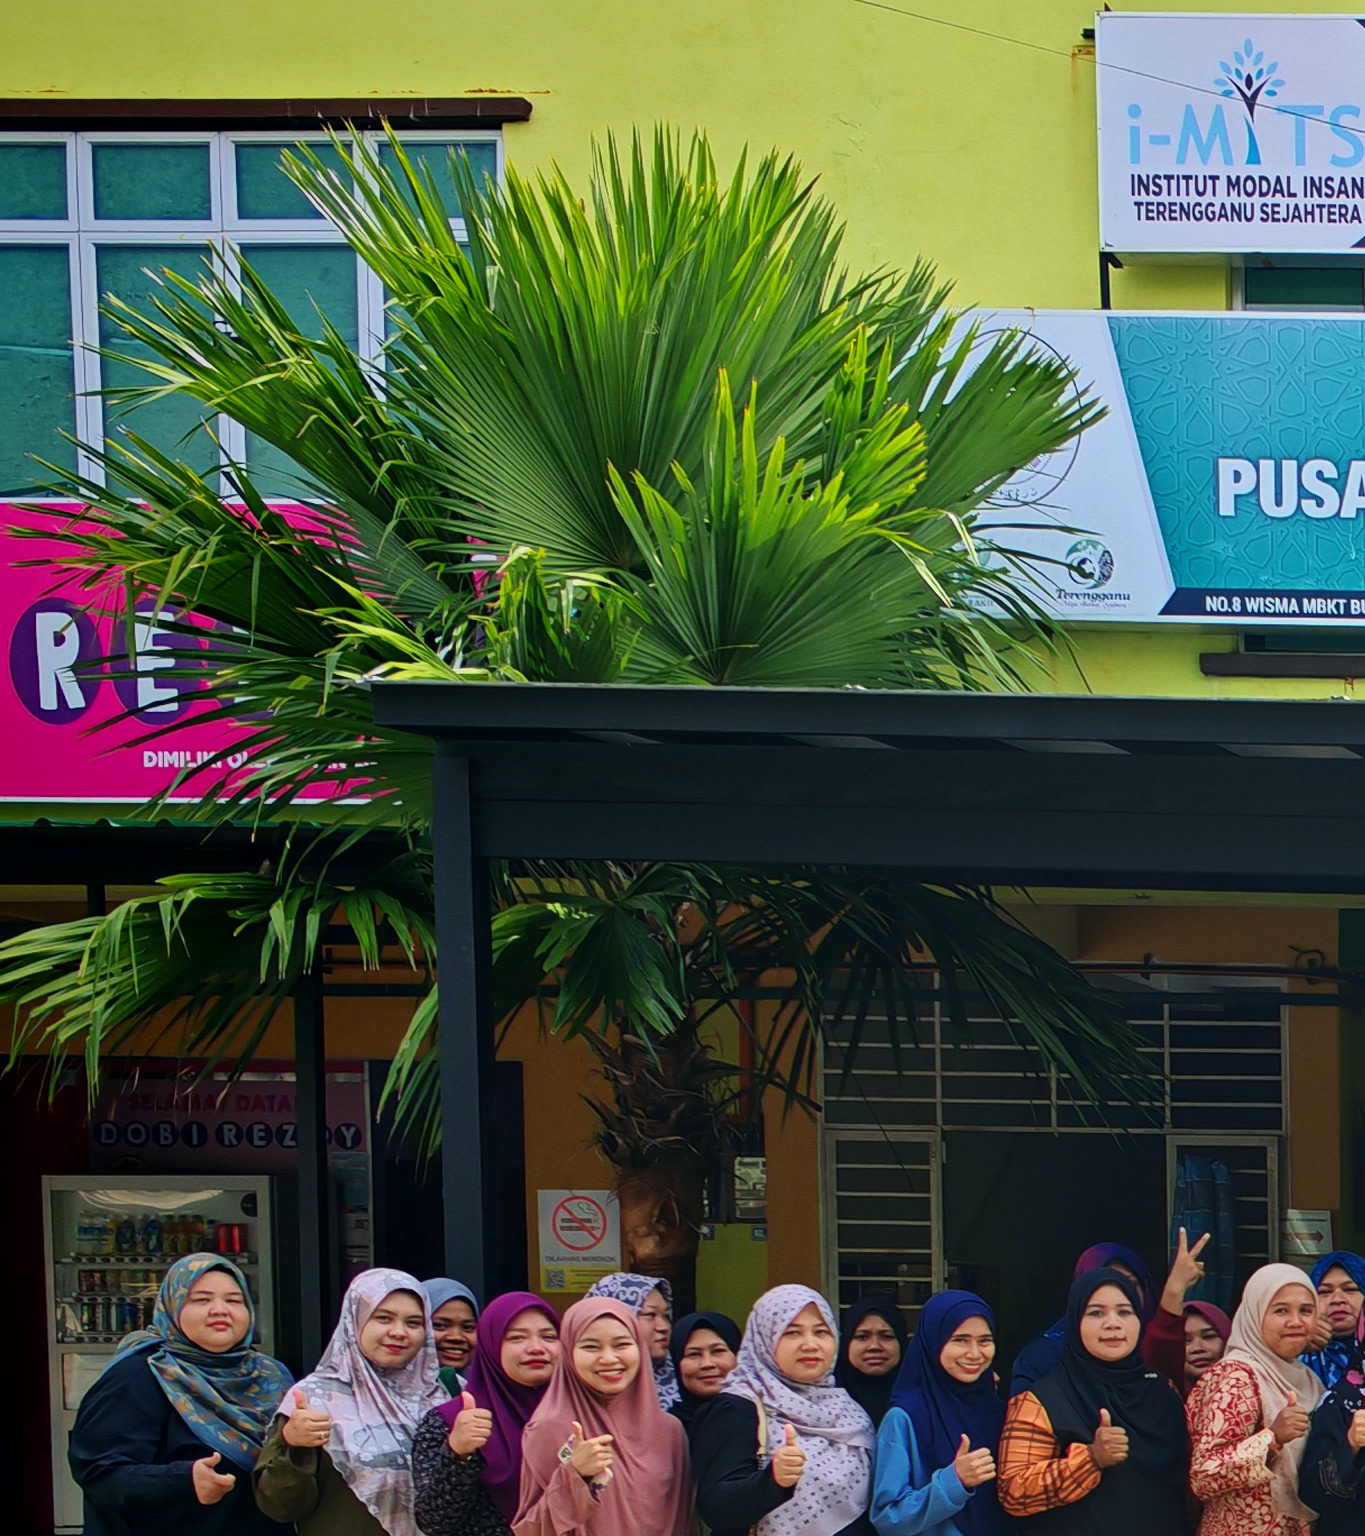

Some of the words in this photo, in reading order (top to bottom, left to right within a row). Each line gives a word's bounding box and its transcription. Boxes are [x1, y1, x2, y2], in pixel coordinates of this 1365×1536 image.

[1130, 173, 1220, 197] INSTITUT
[1226, 175, 1298, 198] MODAL
[1303, 176, 1365, 199] INSAN
[1134, 201, 1255, 223] TERENGGANU
[1259, 202, 1362, 224] SEJAHTERA
[1056, 588, 1131, 602] Terengganu
[1205, 595, 1242, 613] NO.8
[1244, 597, 1300, 614] WISMA
[1303, 598, 1348, 615] MBKT
[222, 1123, 357, 1149] REZY
